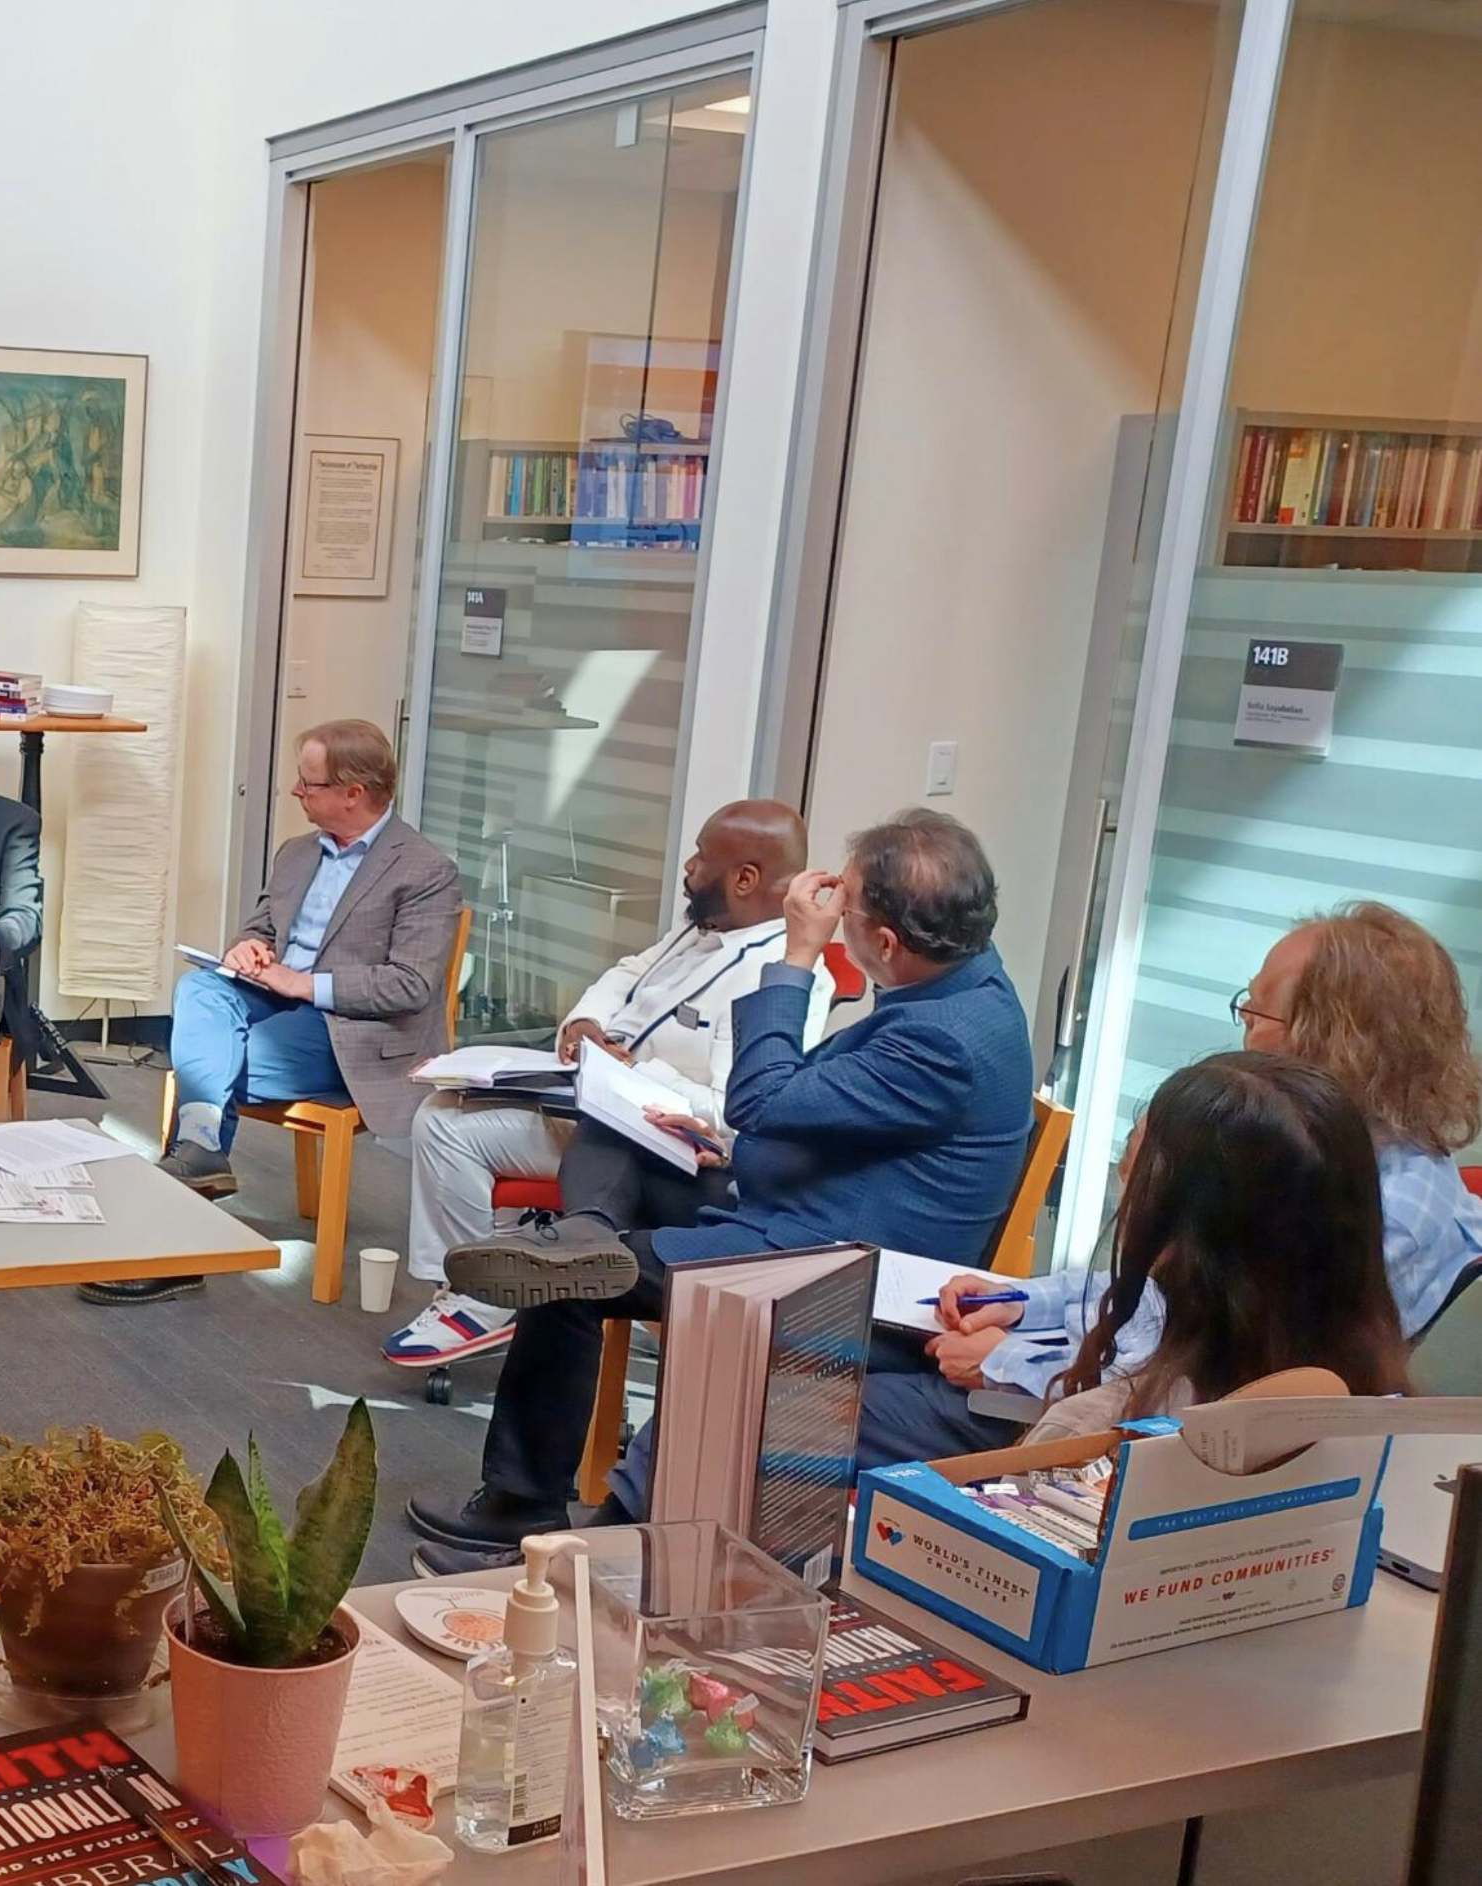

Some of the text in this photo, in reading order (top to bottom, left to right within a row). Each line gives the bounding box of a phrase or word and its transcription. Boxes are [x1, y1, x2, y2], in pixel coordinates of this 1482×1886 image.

[1253, 646, 1289, 666] 141B
[913, 1534, 970, 1569] WORLD'S
[927, 1556, 1007, 1602] CHOCOLATE
[1124, 1549, 1330, 1605] WE FUND COMMUNITIES
[32, 1847, 77, 1866] THE
[175, 1816, 200, 1830] OF
